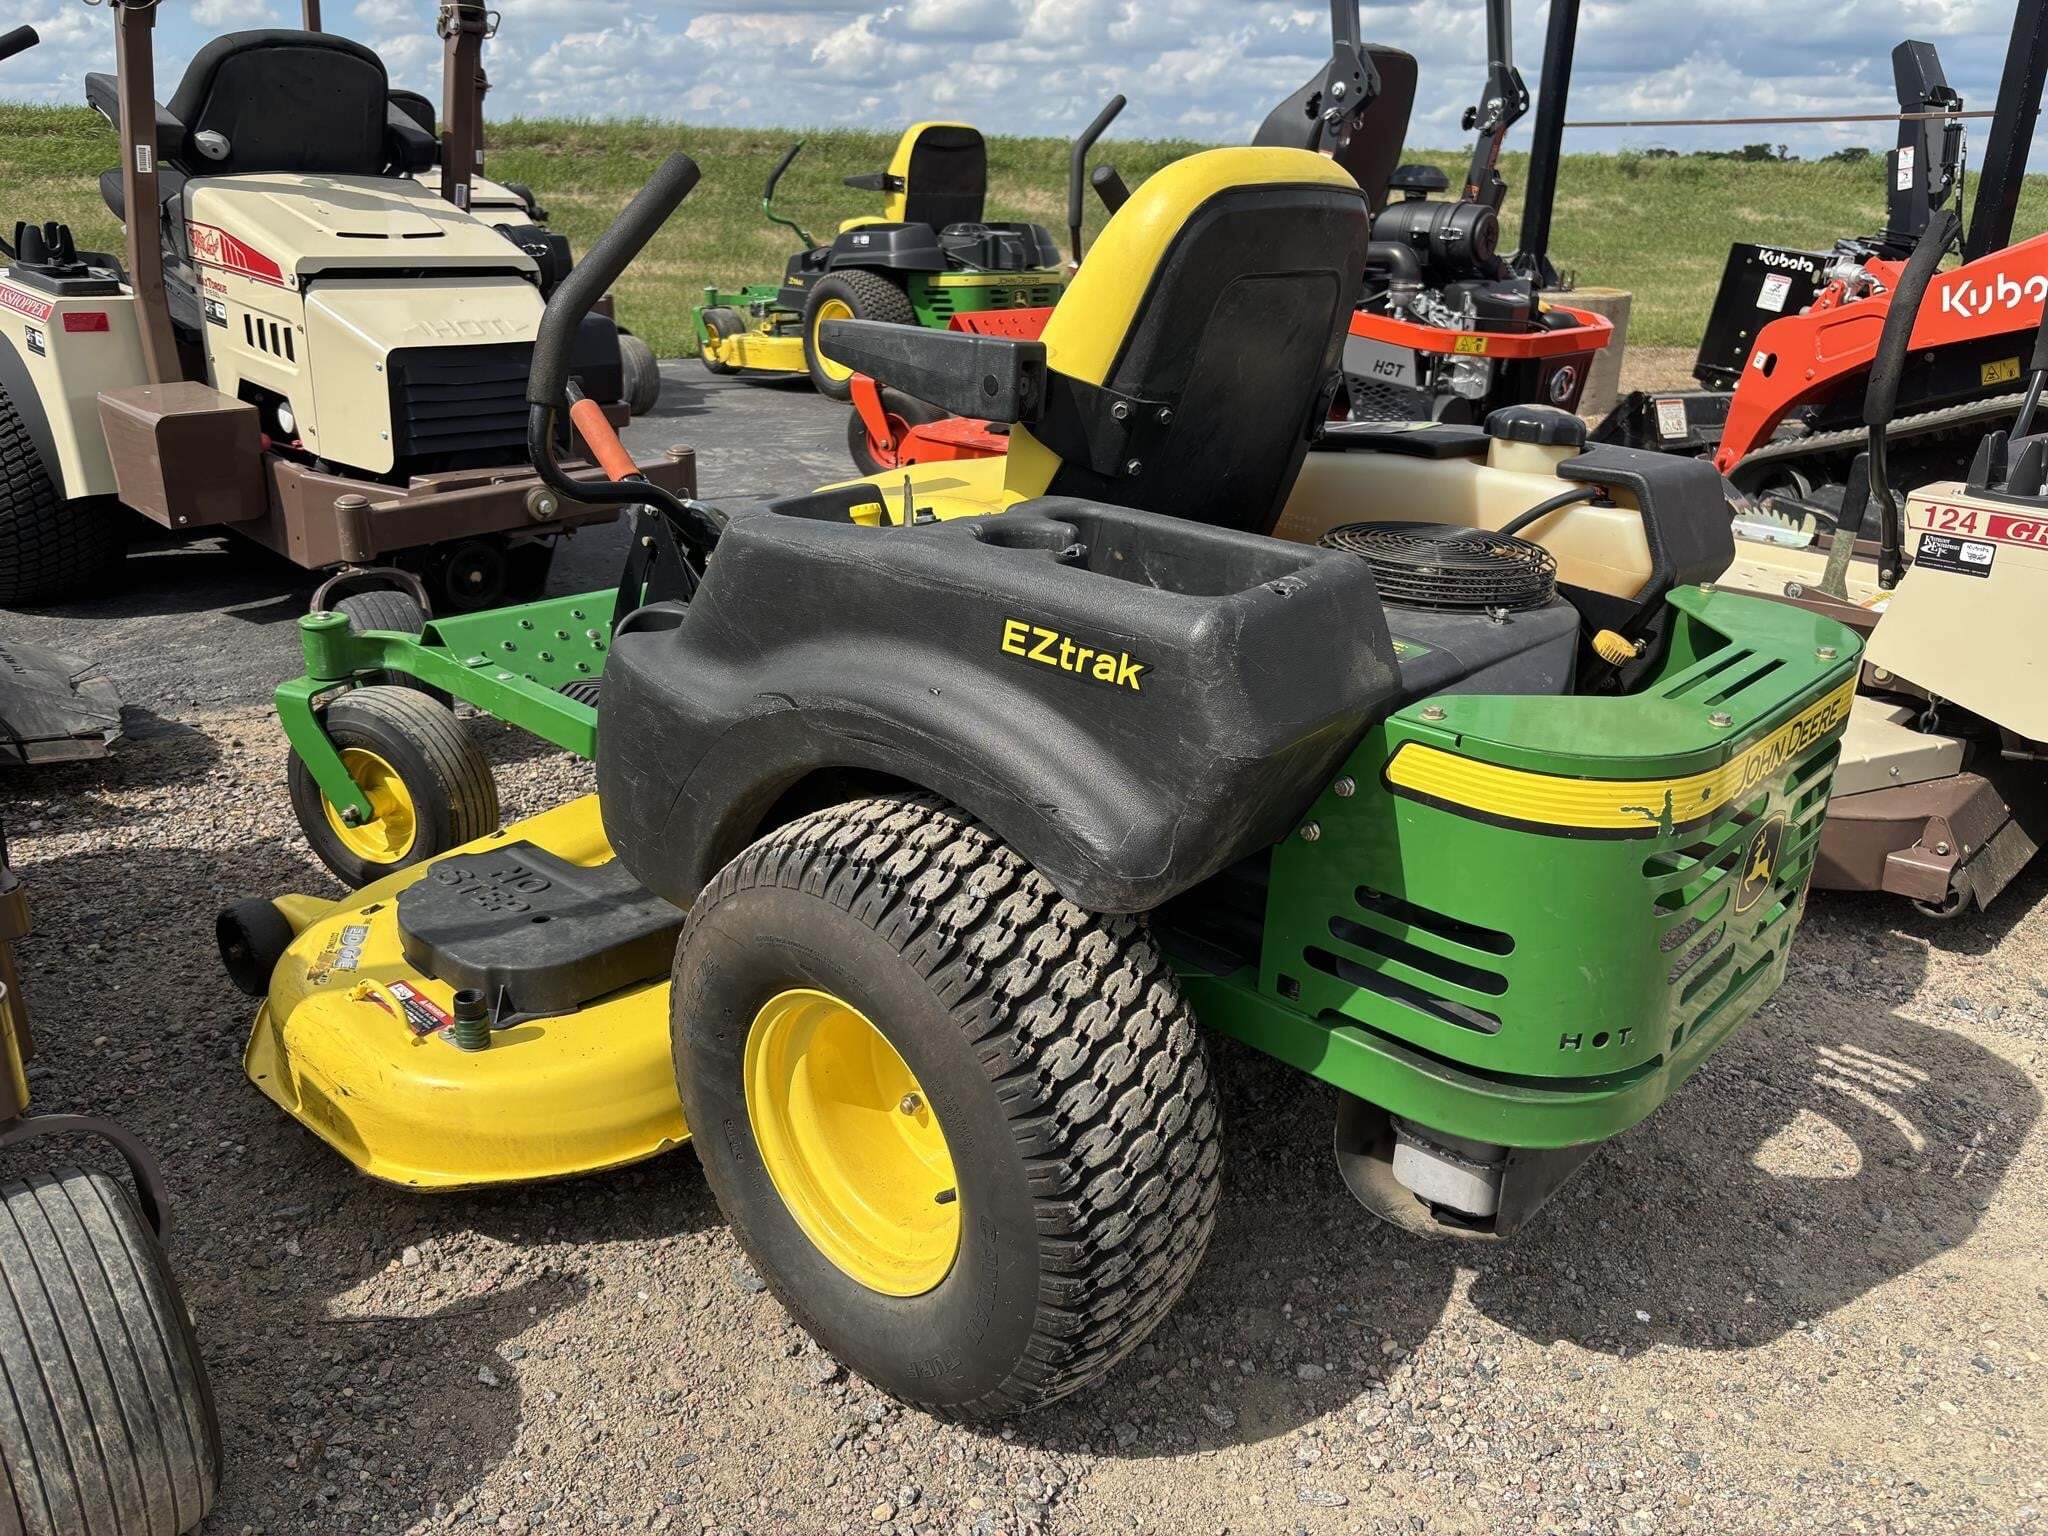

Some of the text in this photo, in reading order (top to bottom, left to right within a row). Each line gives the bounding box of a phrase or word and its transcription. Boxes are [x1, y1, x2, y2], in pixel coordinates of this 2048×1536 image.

[1759, 249, 1814, 273] Kubota
[1373, 359, 1406, 379] HOT
[1925, 506, 1977, 534] 124
[1001, 618, 1145, 691] EZtrak
[1733, 698, 1841, 797] JOHN DEERE
[439, 864, 532, 912] STEP
[488, 866, 552, 894] NO
[333, 923, 369, 970] EDGE
